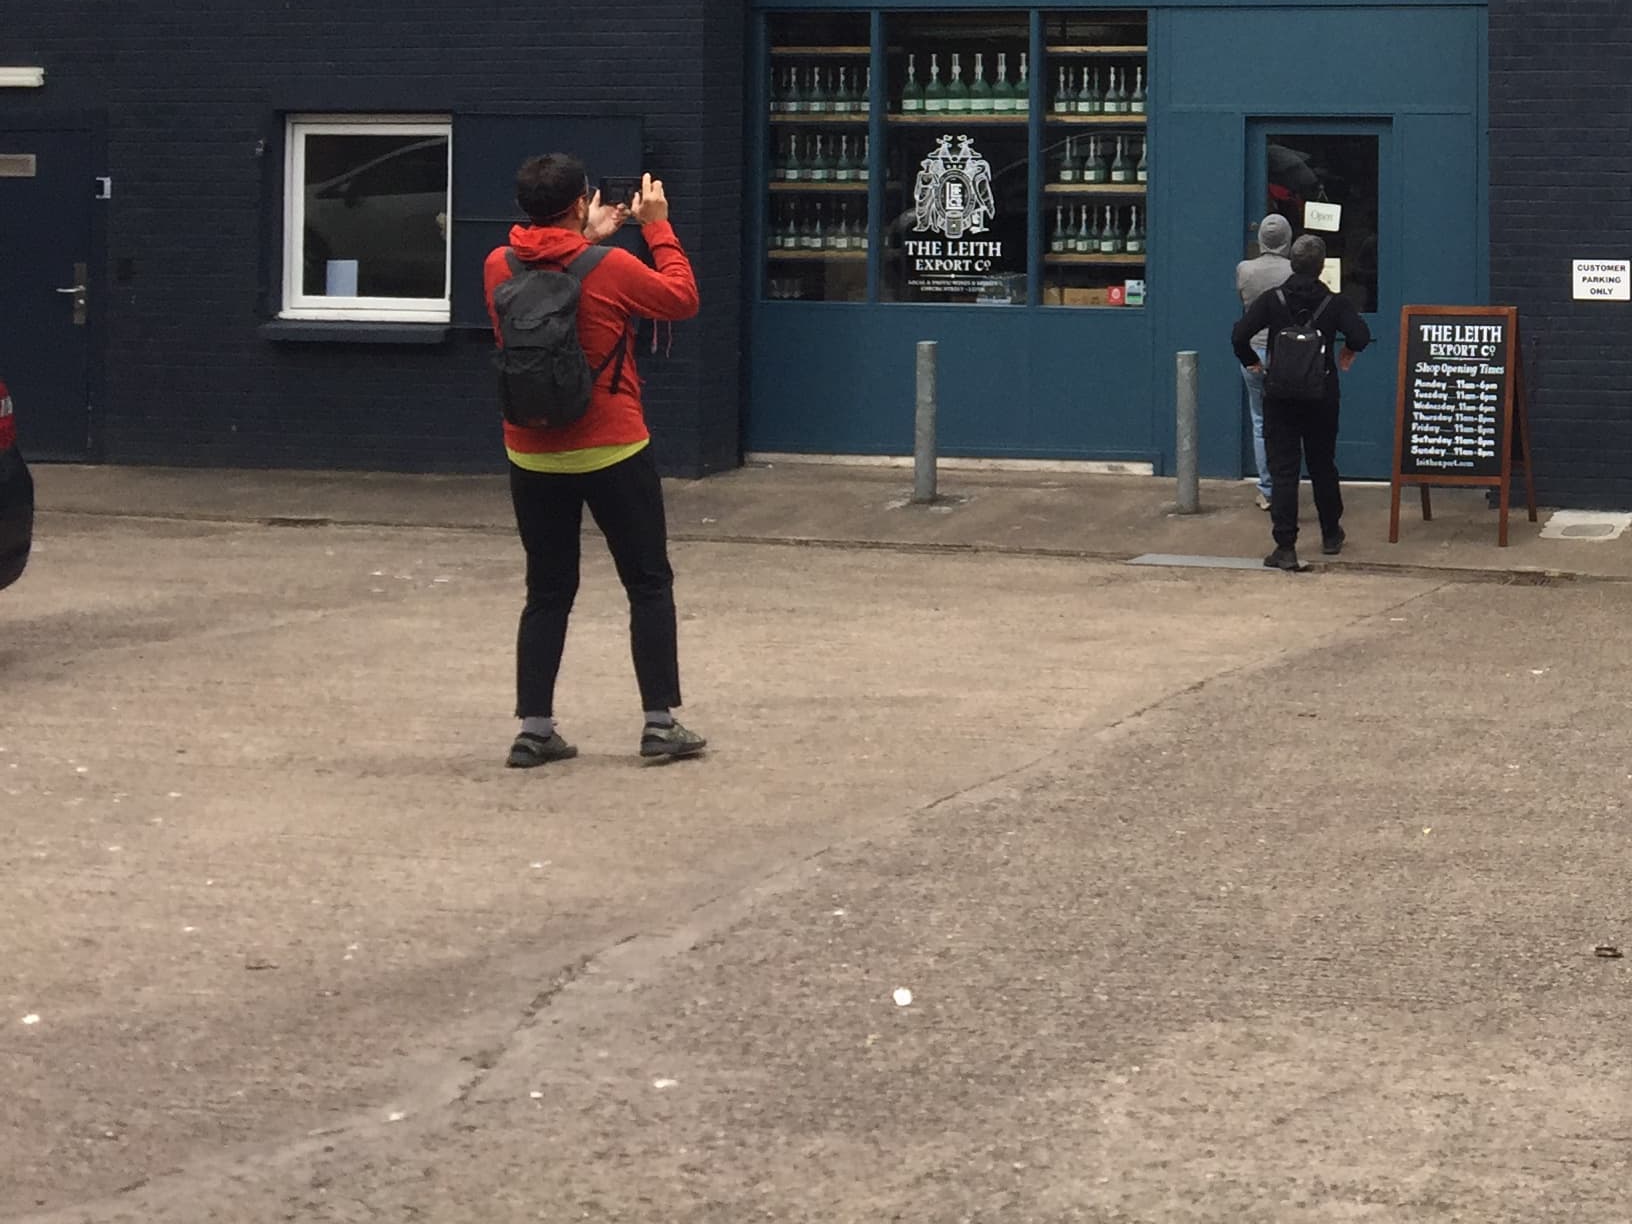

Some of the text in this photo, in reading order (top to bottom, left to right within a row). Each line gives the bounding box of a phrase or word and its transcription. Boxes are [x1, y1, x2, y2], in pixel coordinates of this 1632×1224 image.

[904, 240, 1003, 257] THE LEITH
[915, 258, 973, 272] EXPORT
[1576, 264, 1626, 272] CUSTOMER
[1581, 276, 1622, 284] PARKING
[1589, 287, 1614, 295] ONLY
[1419, 324, 1503, 343] THE LEITH
[1429, 343, 1478, 356] EXPORT
[1415, 362, 1505, 377] Shop Opening Times
[1413, 378, 1447, 390] Monday
[1413, 389, 1448, 401] Tuesday
[1412, 400, 1455, 412] Wednesday
[1412, 412, 1453, 423] Thursday
[1411, 422, 1441, 434] Friday
[1411, 434, 1453, 446] Saturday
[1410, 445, 1447, 456] Sunday
